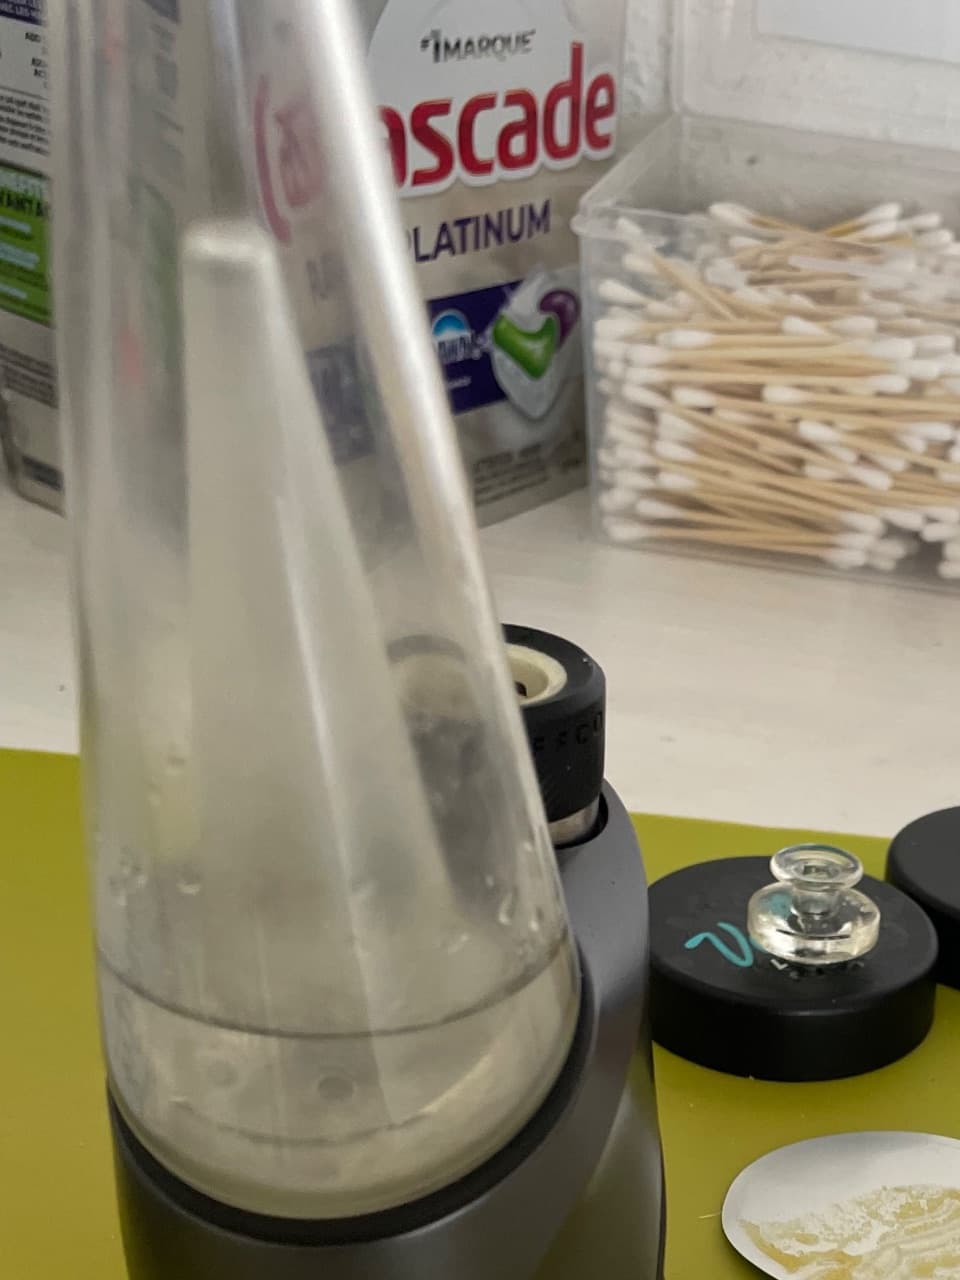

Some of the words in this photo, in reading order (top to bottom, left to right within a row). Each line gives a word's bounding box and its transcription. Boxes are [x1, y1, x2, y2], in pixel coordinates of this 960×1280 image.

[420, 29, 441, 63] #1
[443, 28, 536, 62] MARQUE
[378, 41, 615, 190] ascade
[406, 200, 552, 263] LATINUM
